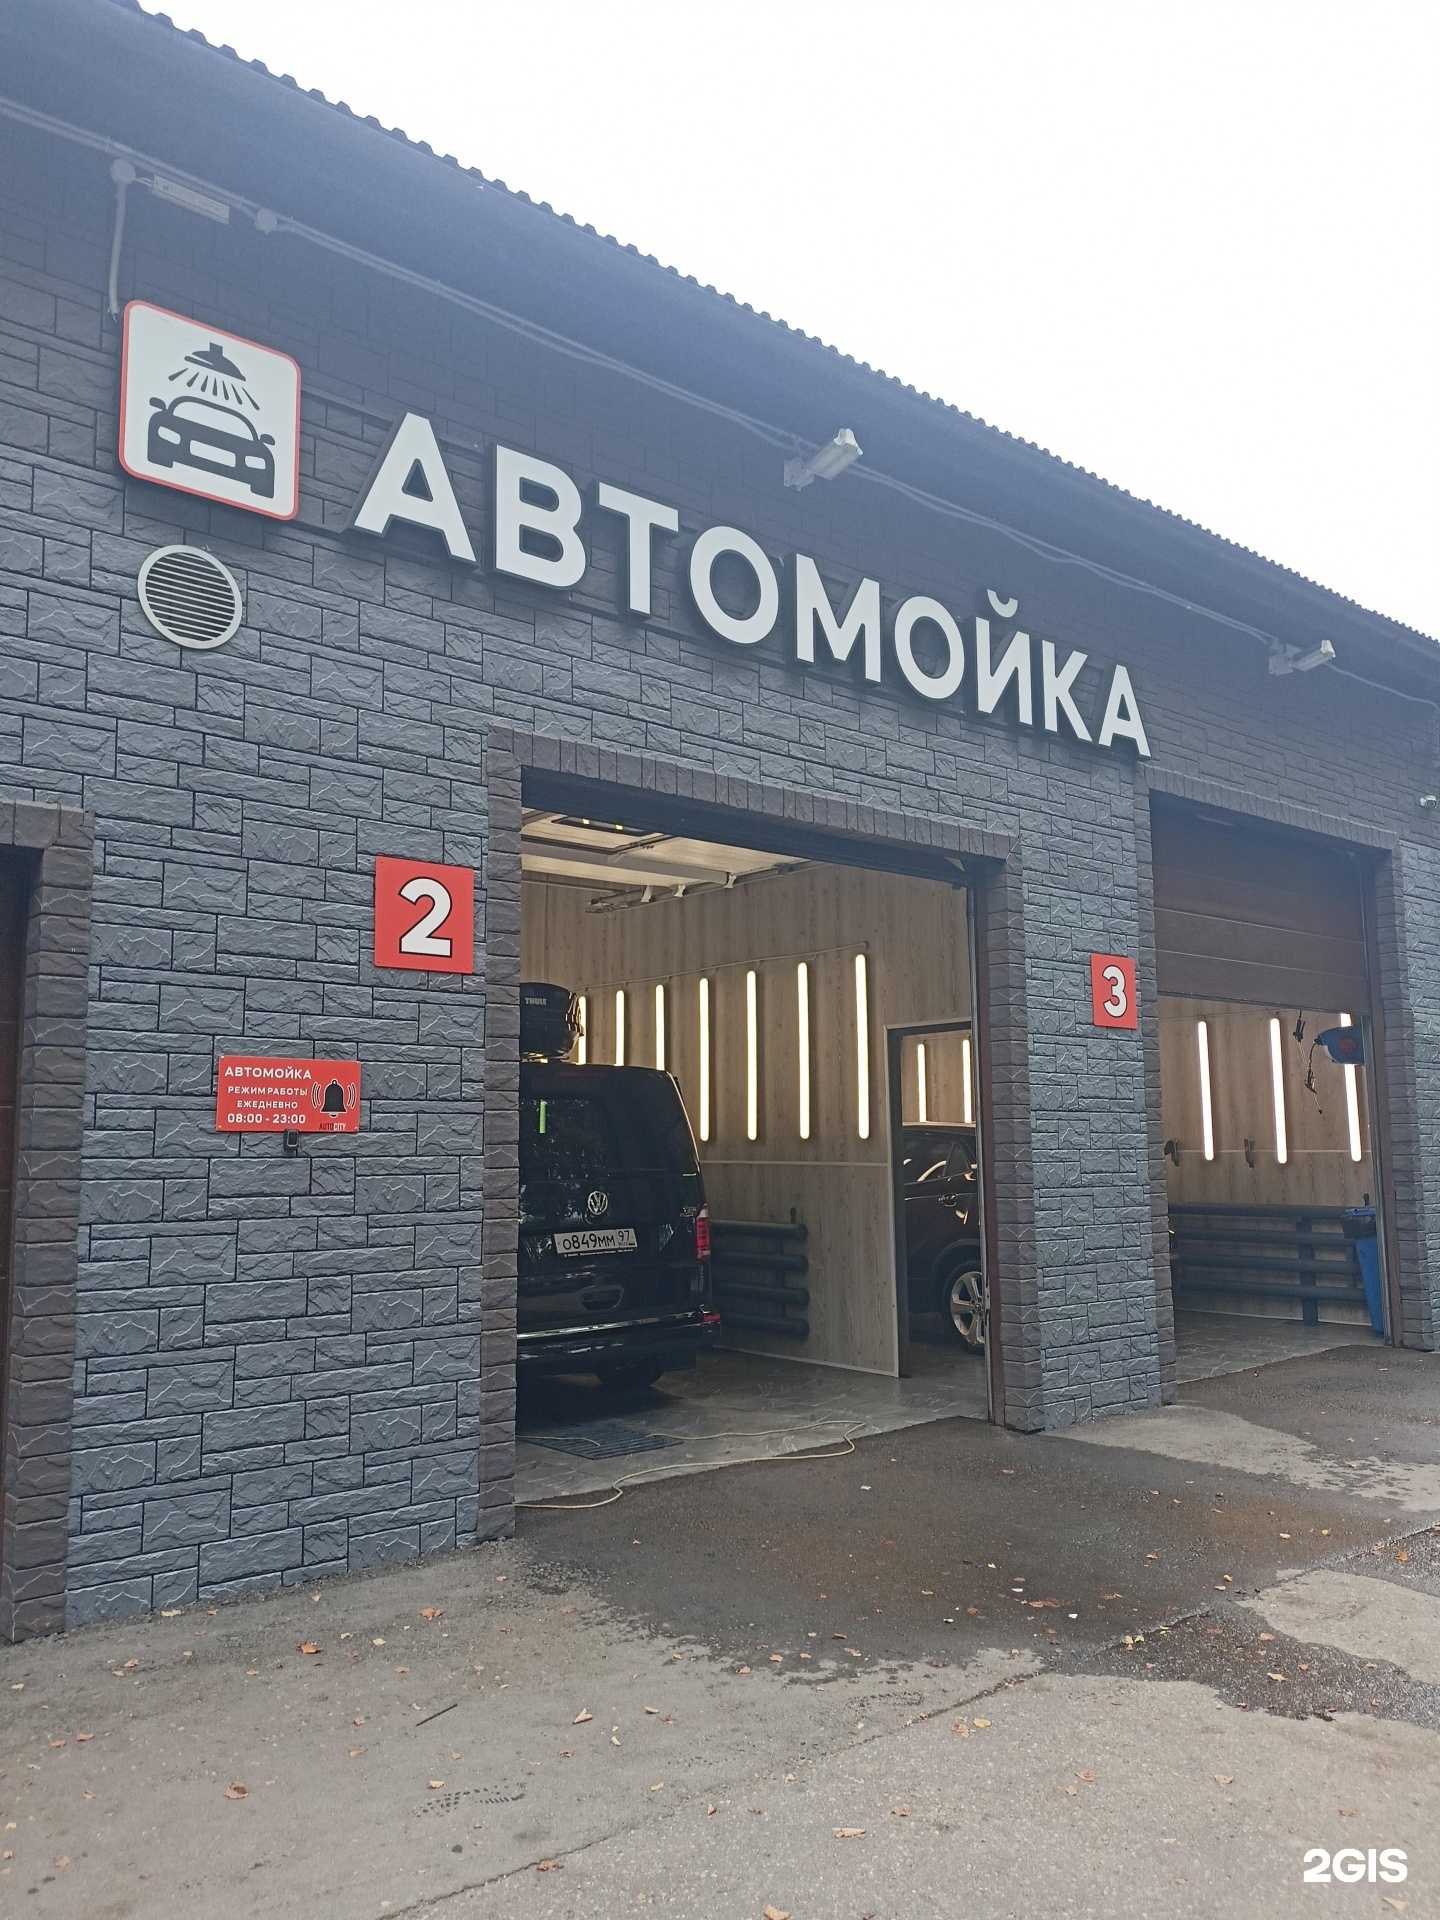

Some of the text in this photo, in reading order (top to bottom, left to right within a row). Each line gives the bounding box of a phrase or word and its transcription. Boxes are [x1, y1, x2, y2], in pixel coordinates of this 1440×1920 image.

[354, 411, 1151, 758] АВТОМОЙКА
[399, 876, 452, 957] 2
[1102, 965, 1127, 1018] 3
[224, 1066, 312, 1080] АВТОМОЙКА
[227, 1086, 308, 1096] РЕЖИМ РАБОТЫ
[236, 1100, 298, 1109] ЕЖЕДНЕВНО
[227, 1113, 263, 1123] 08:00
[272, 1114, 306, 1124] 23:00
